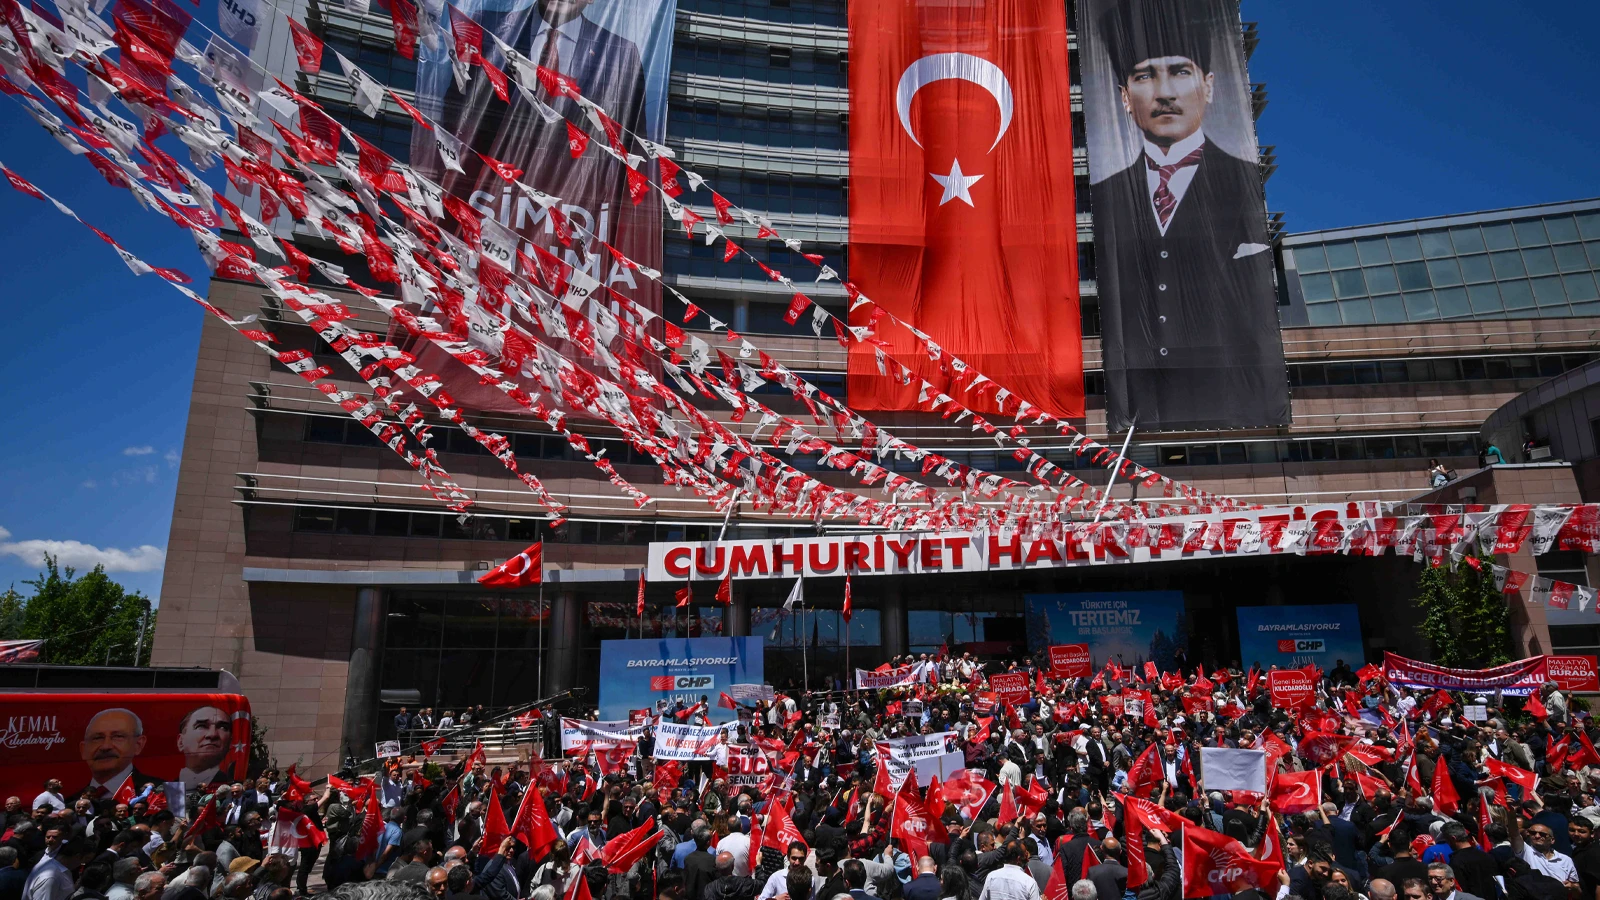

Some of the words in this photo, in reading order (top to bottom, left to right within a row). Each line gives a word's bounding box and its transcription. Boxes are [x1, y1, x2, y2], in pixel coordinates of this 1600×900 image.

[198, 209, 215, 228] CHP
[228, 265, 252, 276] CHP
[664, 535, 970, 576] CUMHURİYET
[1081, 600, 1111, 609] TÜRKİYE
[1113, 600, 1127, 609] İÇİN
[1069, 610, 1141, 625] TERTEMİZ
[1078, 627, 1090, 635] BİR
[1092, 627, 1133, 636] BAŞLANGIÇ
[1258, 623, 1340, 631] BAYRAMLAŞIYORUZ
[1297, 641, 1323, 650] CHP
[627, 657, 737, 668] BAYRAMLAŞIYORUZ
[677, 677, 711, 688] CHP
[1388, 670, 1435, 683] GELECEK
[1438, 674, 1459, 685] İÇİN
[1463, 673, 1544, 685] KILIÇDAROĞLU
[8, 716, 58, 732] KEMAL
[662, 725, 677, 734] HAK
[678, 727, 700, 736] YEMEZ
[656, 749, 678, 757] HALKIN
[904, 819, 927, 833] CHP
[1208, 868, 1243, 883] CHP
